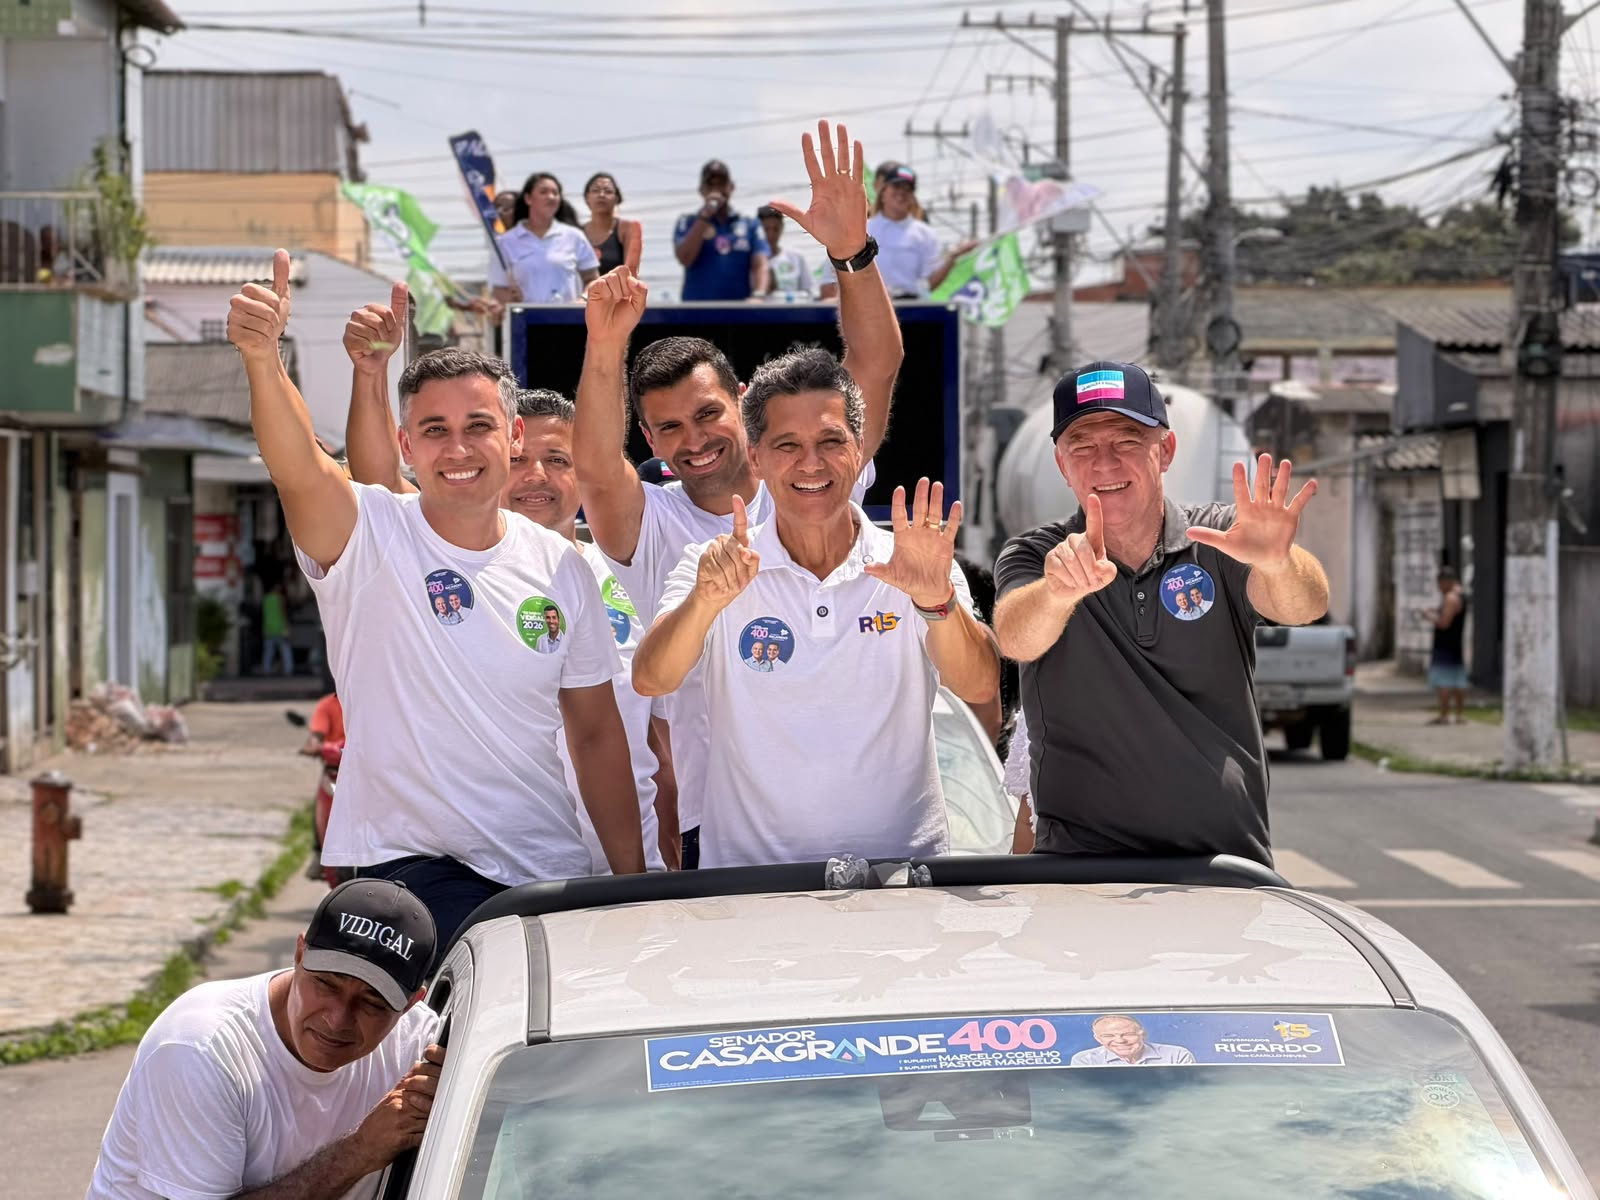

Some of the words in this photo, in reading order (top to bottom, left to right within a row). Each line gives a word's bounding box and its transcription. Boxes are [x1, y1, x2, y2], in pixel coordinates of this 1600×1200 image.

[428, 583, 445, 594] 400
[1167, 578, 1185, 591] 400
[522, 620, 544, 630] 2026
[858, 611, 897, 633] R15
[750, 628, 769, 639] 400
[338, 912, 415, 961] VIDIGAL
[1273, 1023, 1313, 1039] 15
[659, 1033, 947, 1071] CASAGRANDE
[947, 1018, 1058, 1052] 400
[708, 1030, 817, 1049] SENADOR
[1214, 1043, 1322, 1053] RICARDO
[938, 1052, 1003, 1062] MARCELO
[1005, 1050, 1061, 1060] COELHO
[939, 1059, 992, 1070] PASTOR
[994, 1057, 1062, 1067] MARCELO
[1429, 1093, 1450, 1101] OK
